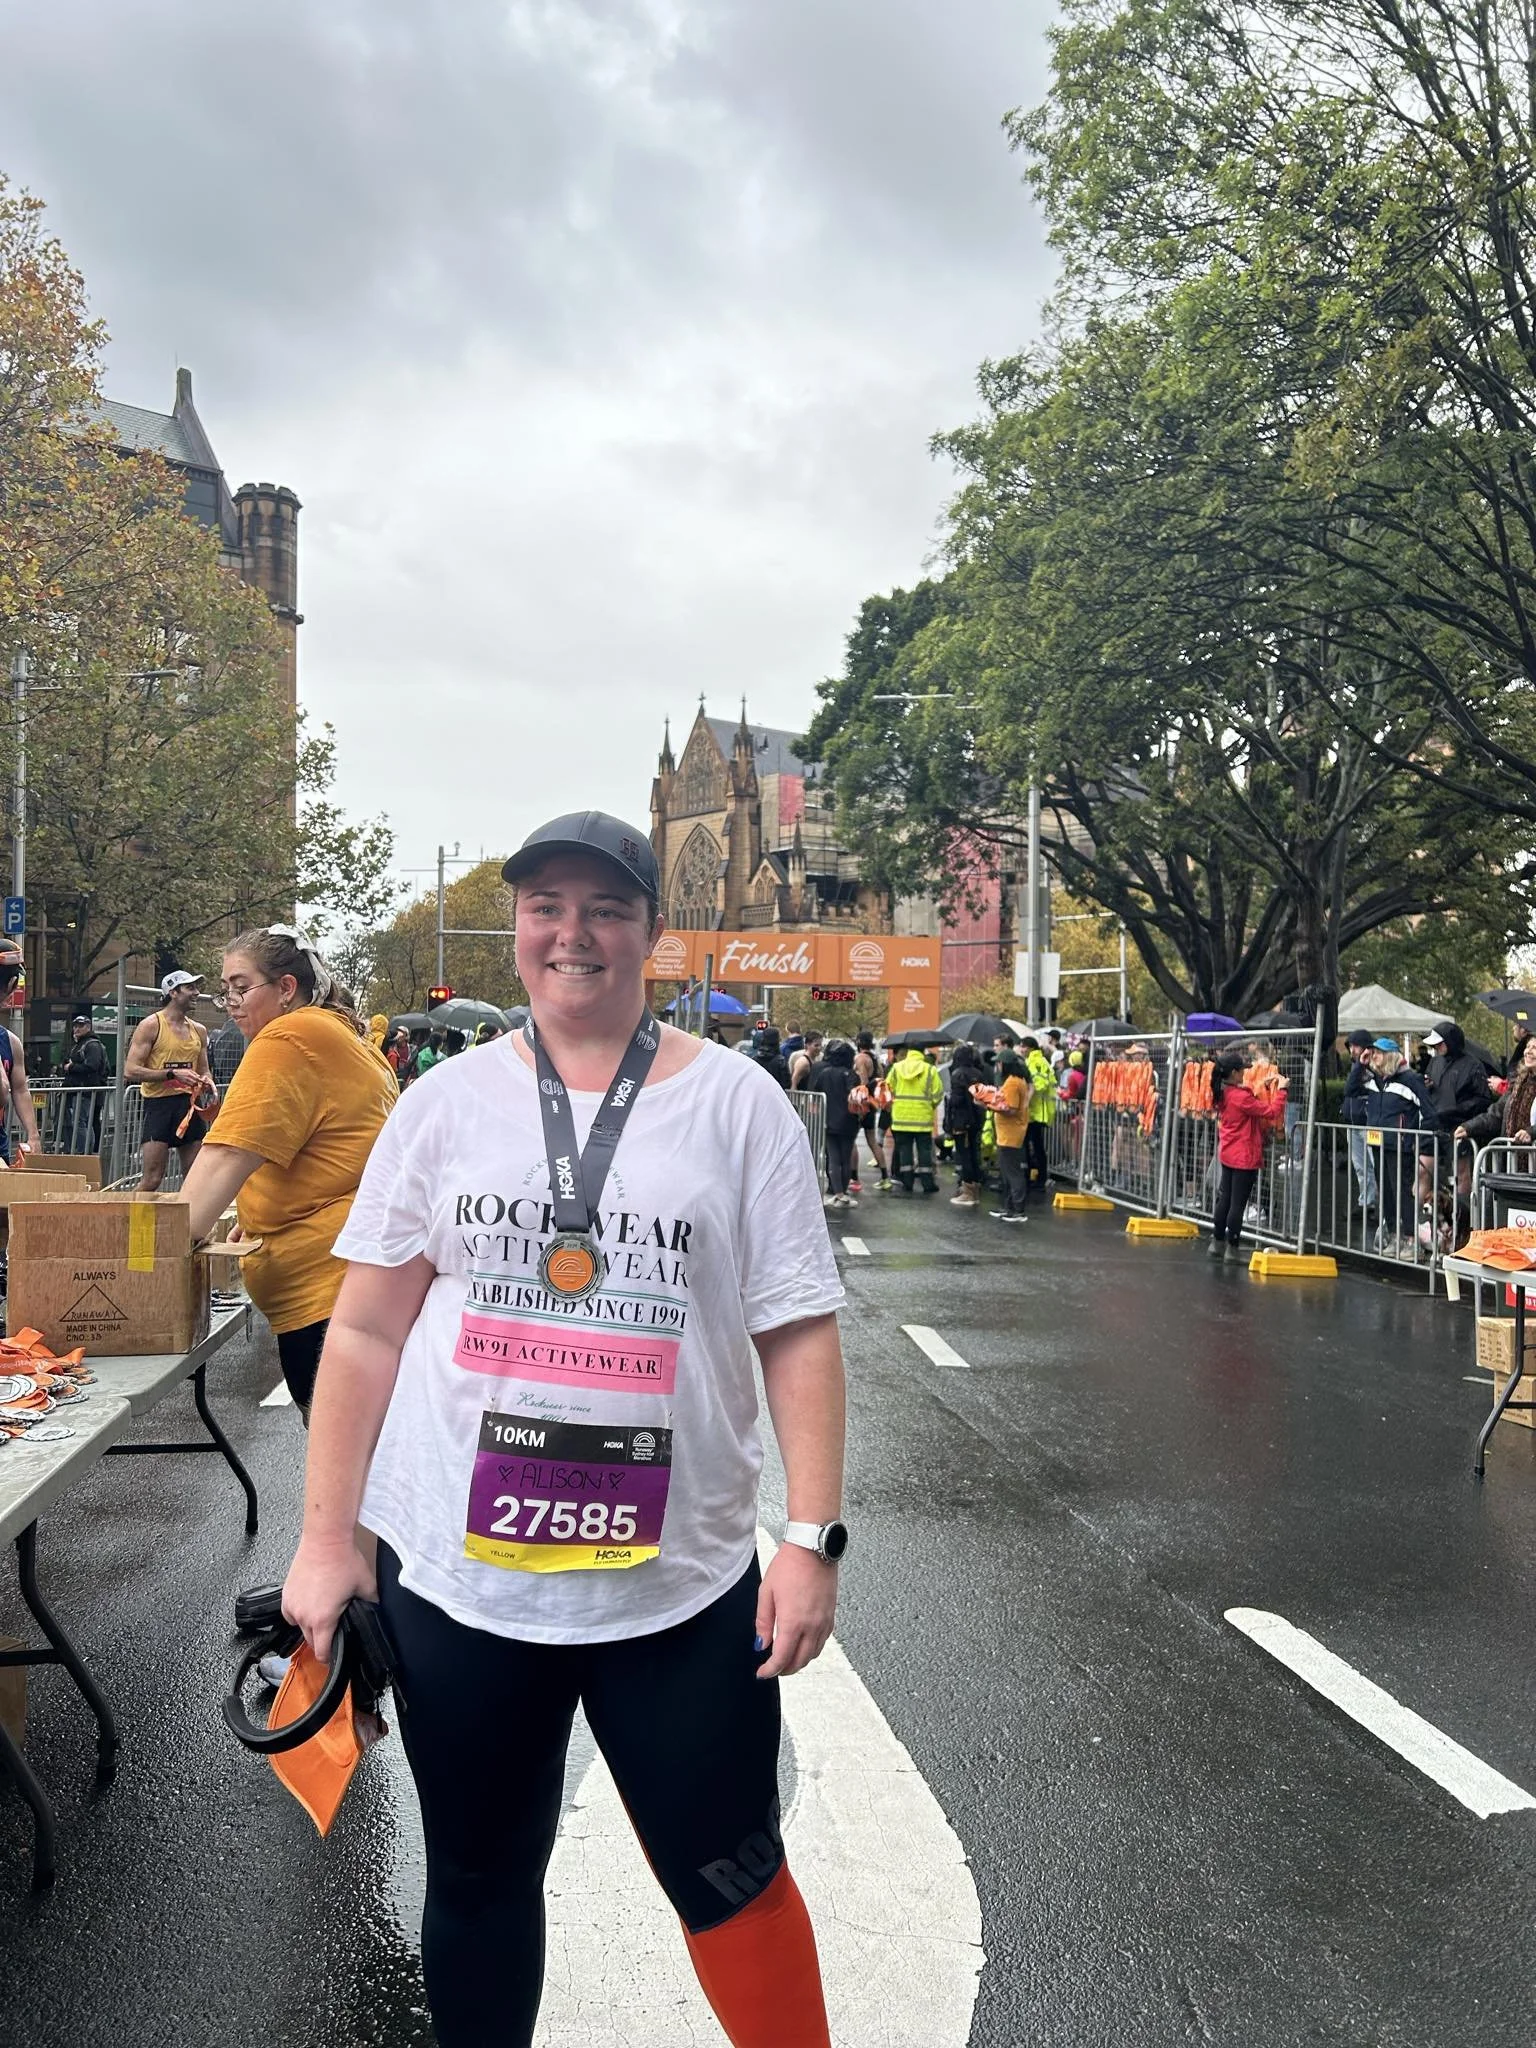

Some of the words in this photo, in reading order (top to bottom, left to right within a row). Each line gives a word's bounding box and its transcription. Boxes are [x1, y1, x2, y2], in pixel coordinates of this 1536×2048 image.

[8, 912, 22, 930] P
[719, 940, 814, 975] Finish
[900, 957, 930, 968] HOKA
[610, 1077, 636, 1107] HOKA
[555, 1155, 576, 1200] HOKA
[73, 1271, 117, 1281] ALWAYS
[70, 1309, 119, 1320] RUNAWAY
[583, 1297, 645, 1323] SINCE
[651, 1305, 687, 1329] 1991
[66, 1324, 88, 1333] MADE
[89, 1324, 98, 1332] IN
[98, 1323, 122, 1332] CHINA
[463, 1335, 509, 1357] RW91
[516, 1345, 658, 1375] ACTIVEWEAR
[494, 1425, 546, 1448] 10KM
[603, 1440, 624, 1449] HOKA
[519, 1462, 603, 1490] ALISON
[490, 1495, 638, 1541] 27585
[490, 1550, 516, 1560] YELLOW
[594, 1549, 632, 1561] HOKA
